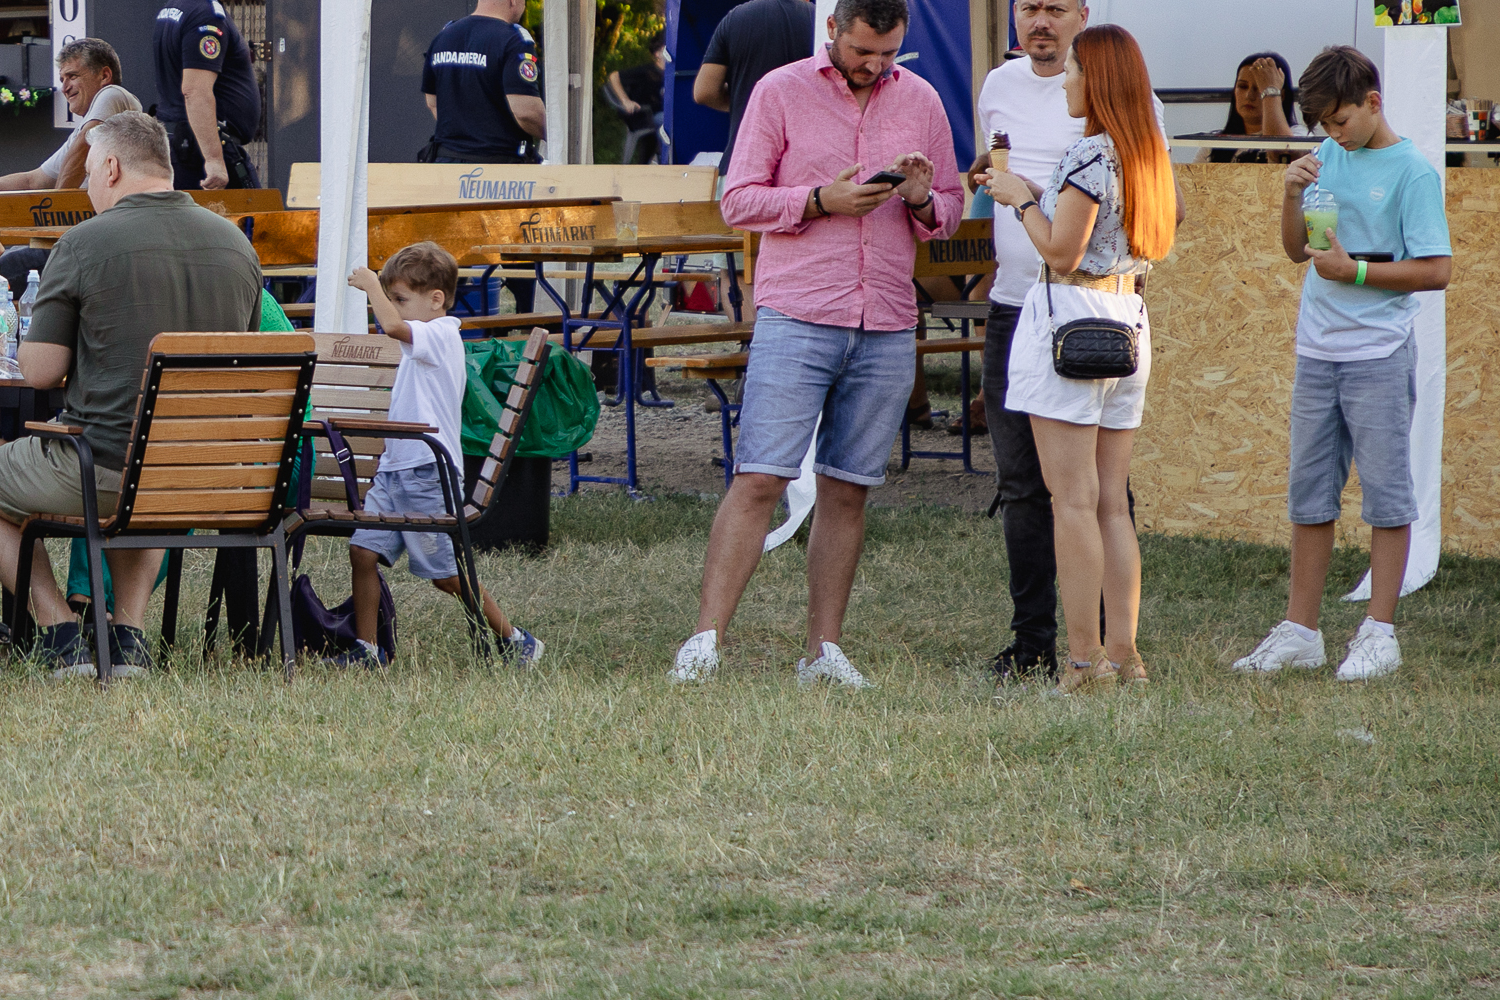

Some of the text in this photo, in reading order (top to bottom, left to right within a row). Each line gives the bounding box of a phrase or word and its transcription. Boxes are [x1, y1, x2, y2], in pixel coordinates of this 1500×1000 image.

[432, 51, 487, 67] JANDARMERIA
[459, 167, 537, 200] NEUMARKT
[30, 197, 98, 227] NEUMAR
[519, 213, 597, 244] NEUMARKT
[331, 336, 383, 360] NEUMARKT
